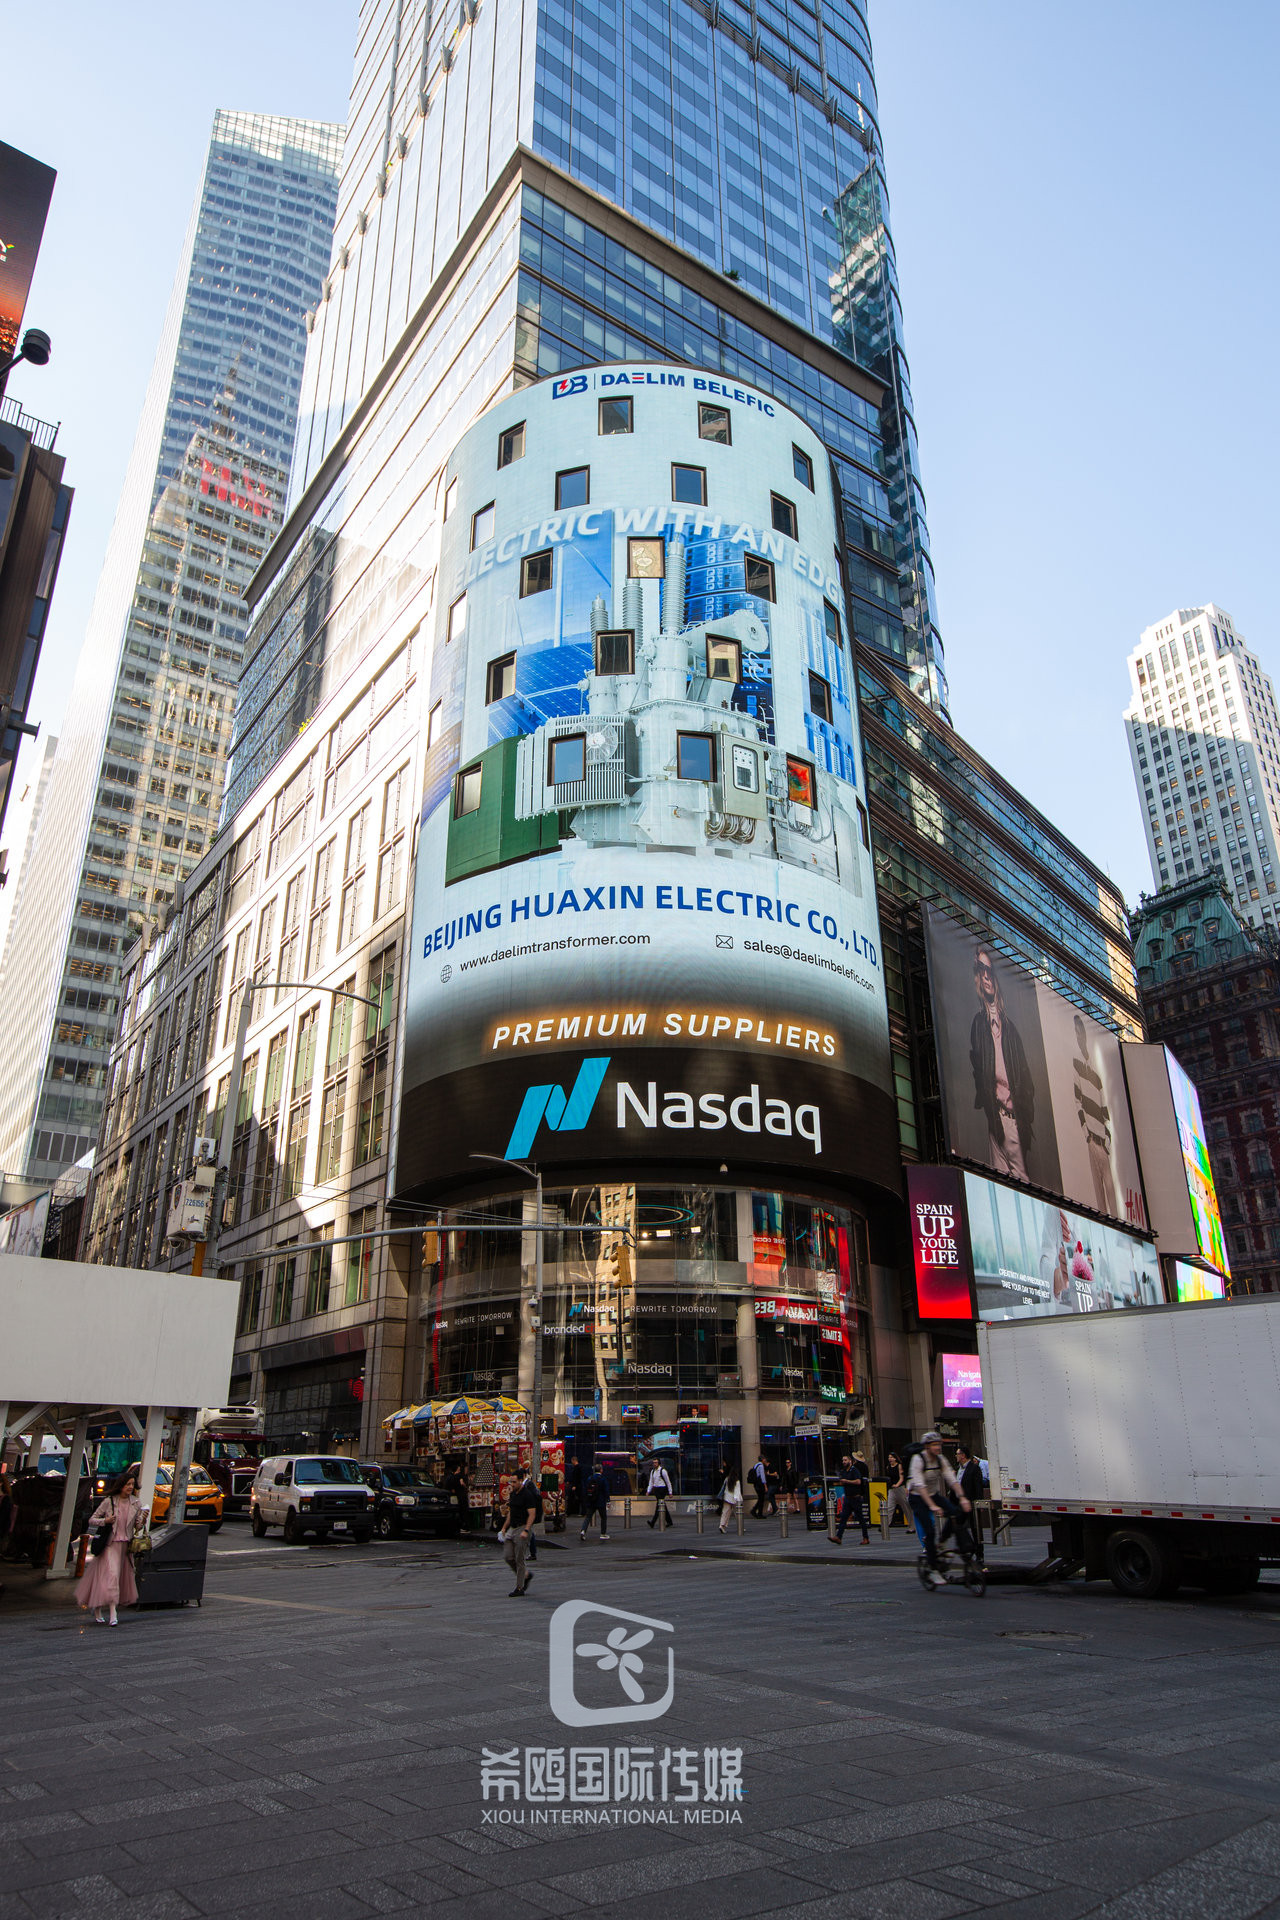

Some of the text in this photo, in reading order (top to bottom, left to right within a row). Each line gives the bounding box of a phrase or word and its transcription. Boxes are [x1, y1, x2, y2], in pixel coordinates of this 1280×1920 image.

[601, 372, 775, 417] DAELIM BELEFIC
[453, 508, 603, 592] ELECTRIC
[614, 507, 722, 539] WITH
[730, 521, 785, 563] AN
[423, 885, 880, 971] BEIJING HUAXIN ELECTRIC CO., LTD.
[460, 933, 650, 972] www.daelimtransformer.com
[743, 939, 875, 995] sales@daelimbelefic.com
[493, 1013, 835, 1056] PREMIUM SUPPLIERS
[617, 1082, 822, 1155] Nasdaq
[916, 1203, 953, 1215] SPAIN
[1125, 1187, 1145, 1228] H&M
[917, 1215, 955, 1237] UP
[919, 1237, 957, 1249] YOUR
[920, 1249, 959, 1264] LIFE
[1075, 1280, 1091, 1294] SPAIN
[583, 1304, 718, 1314] Nasdaq REWRITE TOMORROW
[1077, 1292, 1093, 1312] UP
[477, 1311, 513, 1322] TOMORROW
[628, 1362, 672, 1376] Nasdaq
